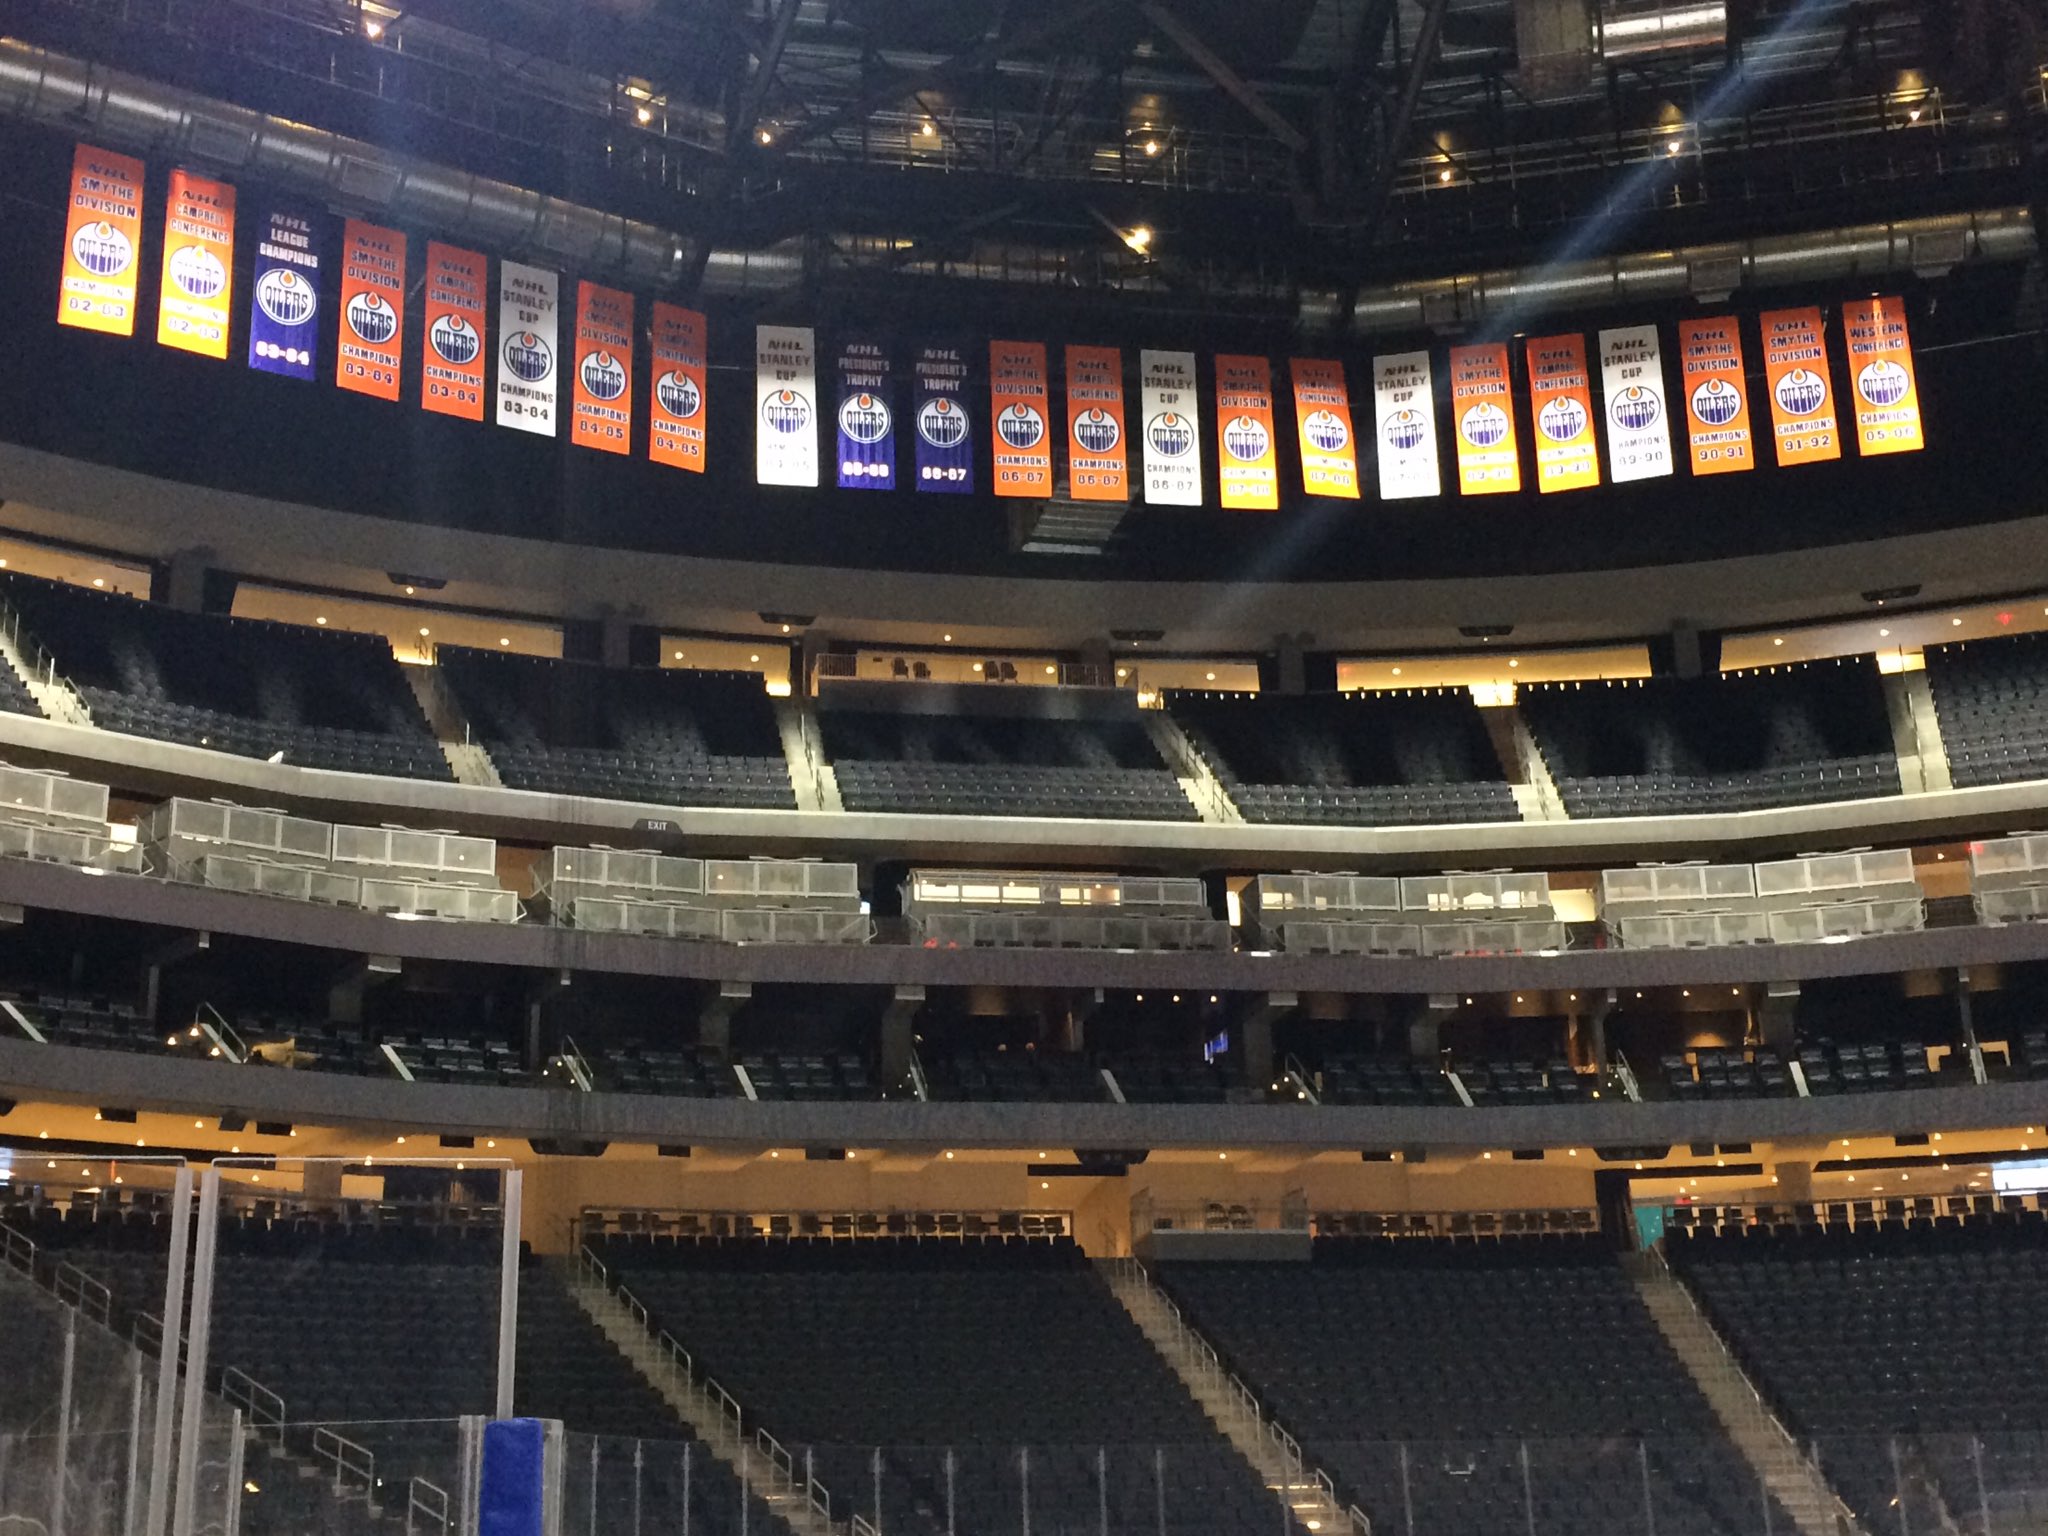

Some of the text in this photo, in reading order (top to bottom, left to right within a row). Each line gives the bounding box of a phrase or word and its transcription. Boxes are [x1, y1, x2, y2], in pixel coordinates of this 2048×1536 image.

[80, 176, 134, 199] SMYTHE
[75, 194, 137, 217] DIVISION
[176, 203, 225, 225] CAMPBELL
[170, 219, 230, 243] CONFERENCE
[270, 213, 311, 232] NHL
[271, 228, 309, 249] LEAGUE
[356, 236, 391, 253] NHL
[259, 242, 319, 268] CHAMPIONS
[351, 250, 398, 272] SMYTHE
[347, 265, 400, 290] DIVISION
[511, 277, 548, 295] NHL
[265, 285, 309, 320] OILERS
[503, 289, 554, 312] STANLEY
[351, 306, 393, 341] OILERS
[518, 310, 539, 325] CUP
[1772, 320, 1810, 333] NHL
[1850, 323, 1904, 338] WESTERN
[581, 326, 629, 347] DIVISION
[1690, 330, 1729, 342] NHL
[1770, 332, 1817, 348] SMYTHE
[435, 328, 476, 362] OILERS
[767, 339, 804, 351] NHL
[846, 344, 882, 356] NHL
[1610, 339, 1649, 351] NHL
[1688, 343, 1734, 357] SMYTHE
[1851, 338, 1905, 353] CONFERENCE
[341, 343, 399, 367] CHAMPIONS
[508, 345, 548, 379] OILERS
[759, 353, 812, 367] STANLEY
[923, 349, 961, 361] NHL
[1603, 350, 1657, 367] STANLEY
[1769, 347, 1822, 363] DIVISION
[345, 362, 394, 384] 83-84
[1151, 363, 1186, 376] NHL
[1383, 363, 1420, 377] NHL
[1621, 367, 1643, 380] CUP
[1687, 358, 1739, 373] DIVISION
[426, 365, 482, 387] CHAMPIONS
[584, 365, 622, 398] OILERS
[775, 370, 798, 381] CUP
[846, 373, 882, 388] TROPHY
[1143, 376, 1194, 391] STANLEY
[1376, 375, 1427, 392] STANLEY
[1458, 368, 1502, 382] SMYTHE
[1534, 376, 1585, 391] CONFERENCE
[429, 383, 477, 404] 83-84
[500, 382, 554, 404] CHAMPIONS
[923, 378, 961, 392] TROPHY
[995, 383, 1044, 396] DIVISION
[1457, 382, 1507, 397] DIVISION
[1863, 374, 1904, 404] OILERS
[661, 384, 698, 416] OILERS
[1159, 392, 1180, 405] CUP
[1221, 396, 1268, 409] DIVISION
[1393, 391, 1414, 403] CUP
[1780, 384, 1822, 414] OILERS
[504, 400, 549, 421] 83-84
[575, 402, 629, 423] CHAMPIONS
[1616, 399, 1656, 429] OILERS
[1697, 394, 1737, 423] OILERS
[767, 405, 807, 434] OILERS
[846, 410, 885, 443] OILERS
[1543, 410, 1583, 440] OILERS
[1777, 418, 1834, 436] CHAMPIONS
[579, 420, 624, 439] 84-85
[653, 419, 703, 440] CHAMPIONS
[924, 414, 963, 443] OILERS
[1001, 418, 1040, 449] OILERS
[1387, 422, 1425, 450] OILERS
[656, 436, 699, 456] 84-85
[1077, 423, 1117, 453] OILERS
[1152, 427, 1190, 457] OILERS
[1228, 431, 1265, 460] OILERS
[1615, 435, 1667, 449] HAMPIONS
[1692, 430, 1748, 445] CHAMPIONS
[1785, 435, 1831, 451] 91-92
[996, 454, 1049, 467] CHAMPIONS
[1699, 446, 1745, 460] 90-91
[1072, 459, 1125, 471] CHAMPIONS
[1146, 463, 1197, 475] CHAMPIONS
[1001, 471, 1045, 484] 86-87
[1077, 475, 1121, 487] 86-87
[1151, 479, 1194, 492] 86-87
[647, 820, 668, 831] EXIT
